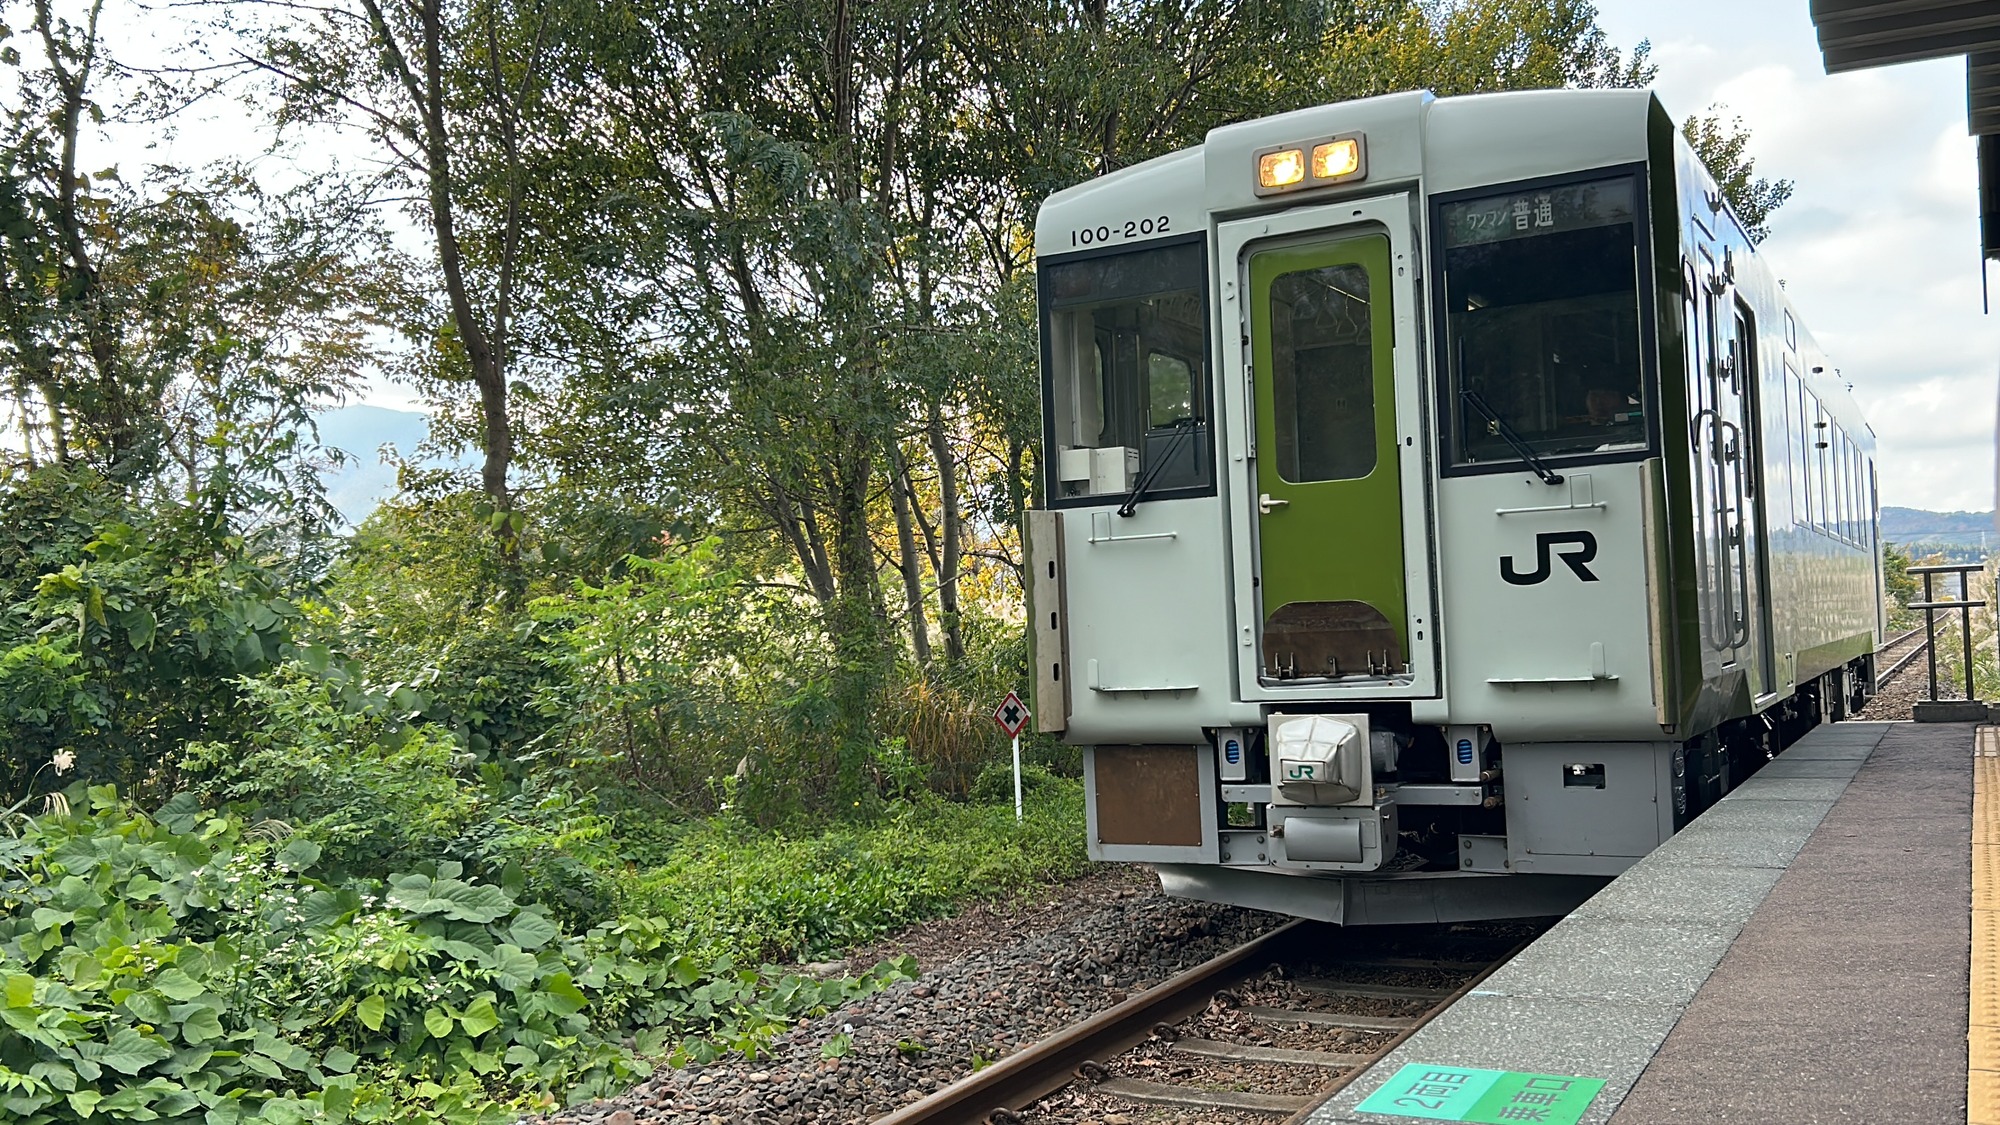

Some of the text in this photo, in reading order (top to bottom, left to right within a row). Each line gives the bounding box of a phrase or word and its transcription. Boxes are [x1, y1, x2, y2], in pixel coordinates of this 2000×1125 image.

[1512, 193, 1554, 231] 普通
[1072, 216, 1170, 247] 100-202
[1500, 530, 1600, 586] JR
[1289, 765, 1314, 780] JR
[1393, 1071, 1472, 1109] 2両目
[1497, 1077, 1575, 1123] 乗車口
